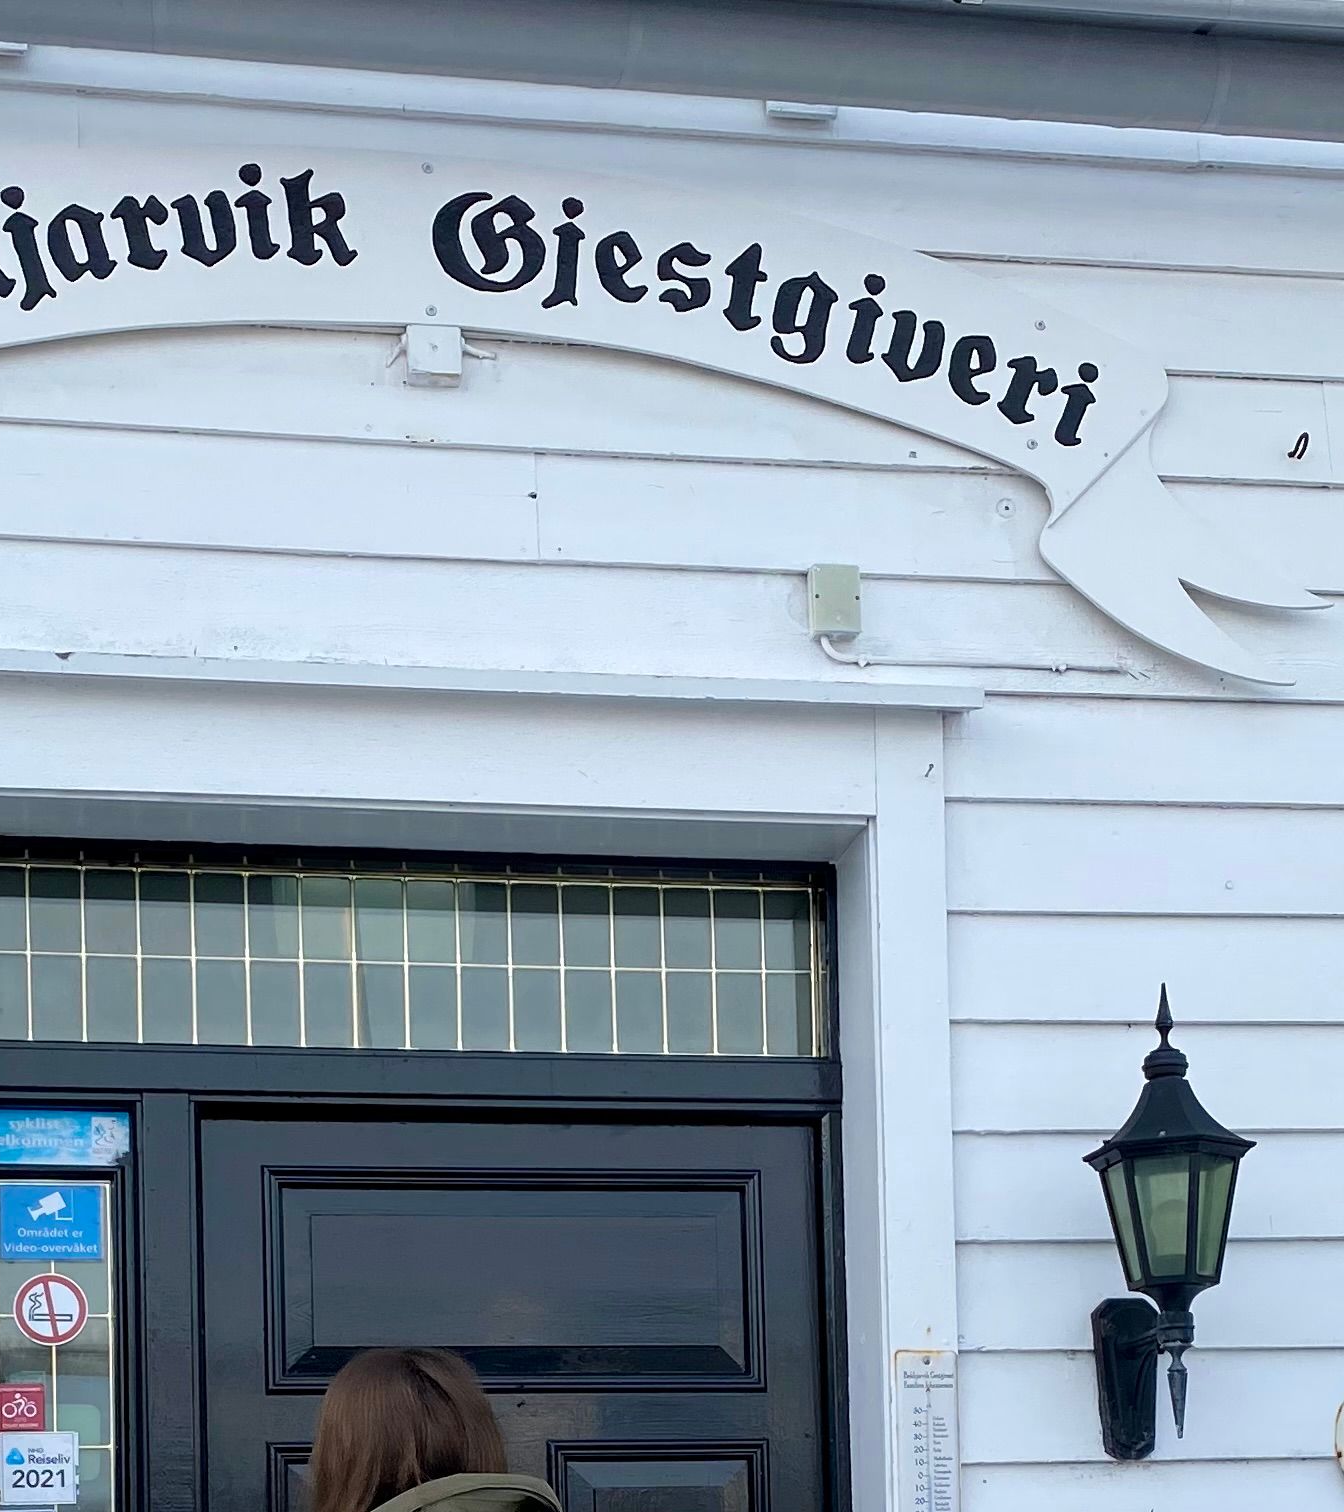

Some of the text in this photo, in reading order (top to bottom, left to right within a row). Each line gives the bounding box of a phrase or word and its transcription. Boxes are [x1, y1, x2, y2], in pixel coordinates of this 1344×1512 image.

[432, 191, 1099, 446] Gjestgiveri
[17, 1227, 84, 1238] Området er
[913, 1445, 924, 1453] 20
[27, 1453, 71, 1465] Reiseliv
[915, 1458, 924, 1466] 10
[12, 1469, 65, 1489] 2021
[915, 1484, 925, 1492] 10
[915, 1497, 925, 1505] 20
